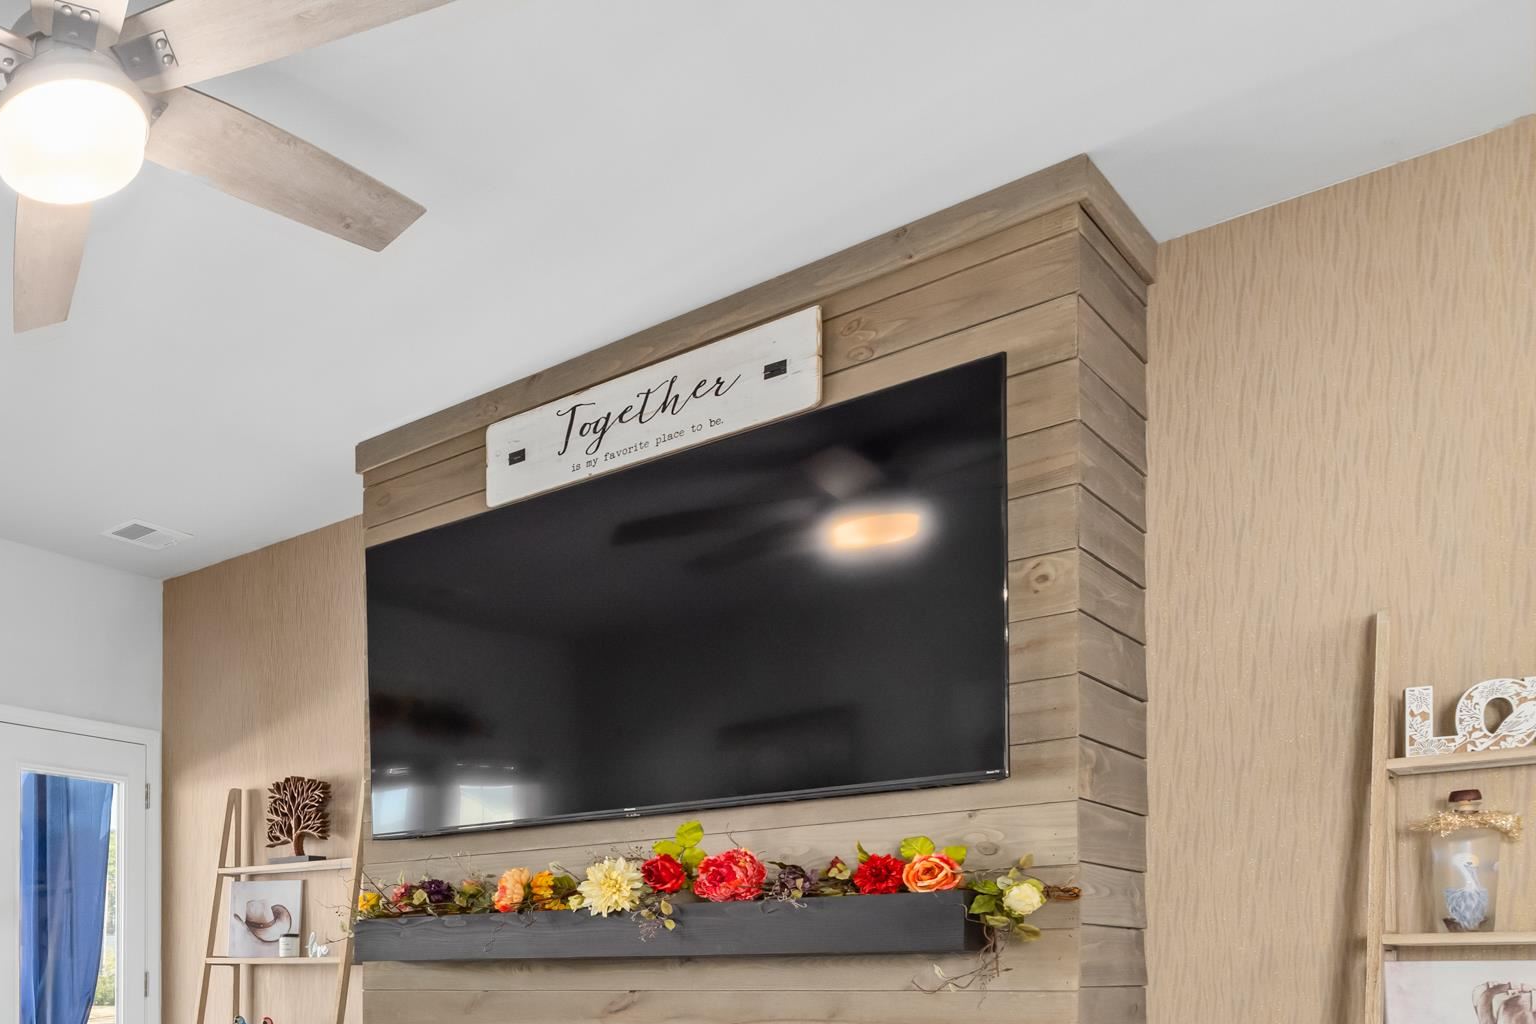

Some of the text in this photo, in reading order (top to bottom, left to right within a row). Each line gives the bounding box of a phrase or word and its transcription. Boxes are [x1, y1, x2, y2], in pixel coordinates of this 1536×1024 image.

[556, 374, 742, 456] Together
[571, 417, 724, 472] is my favorite place to be.
[1405, 676, 1536, 758] LO
